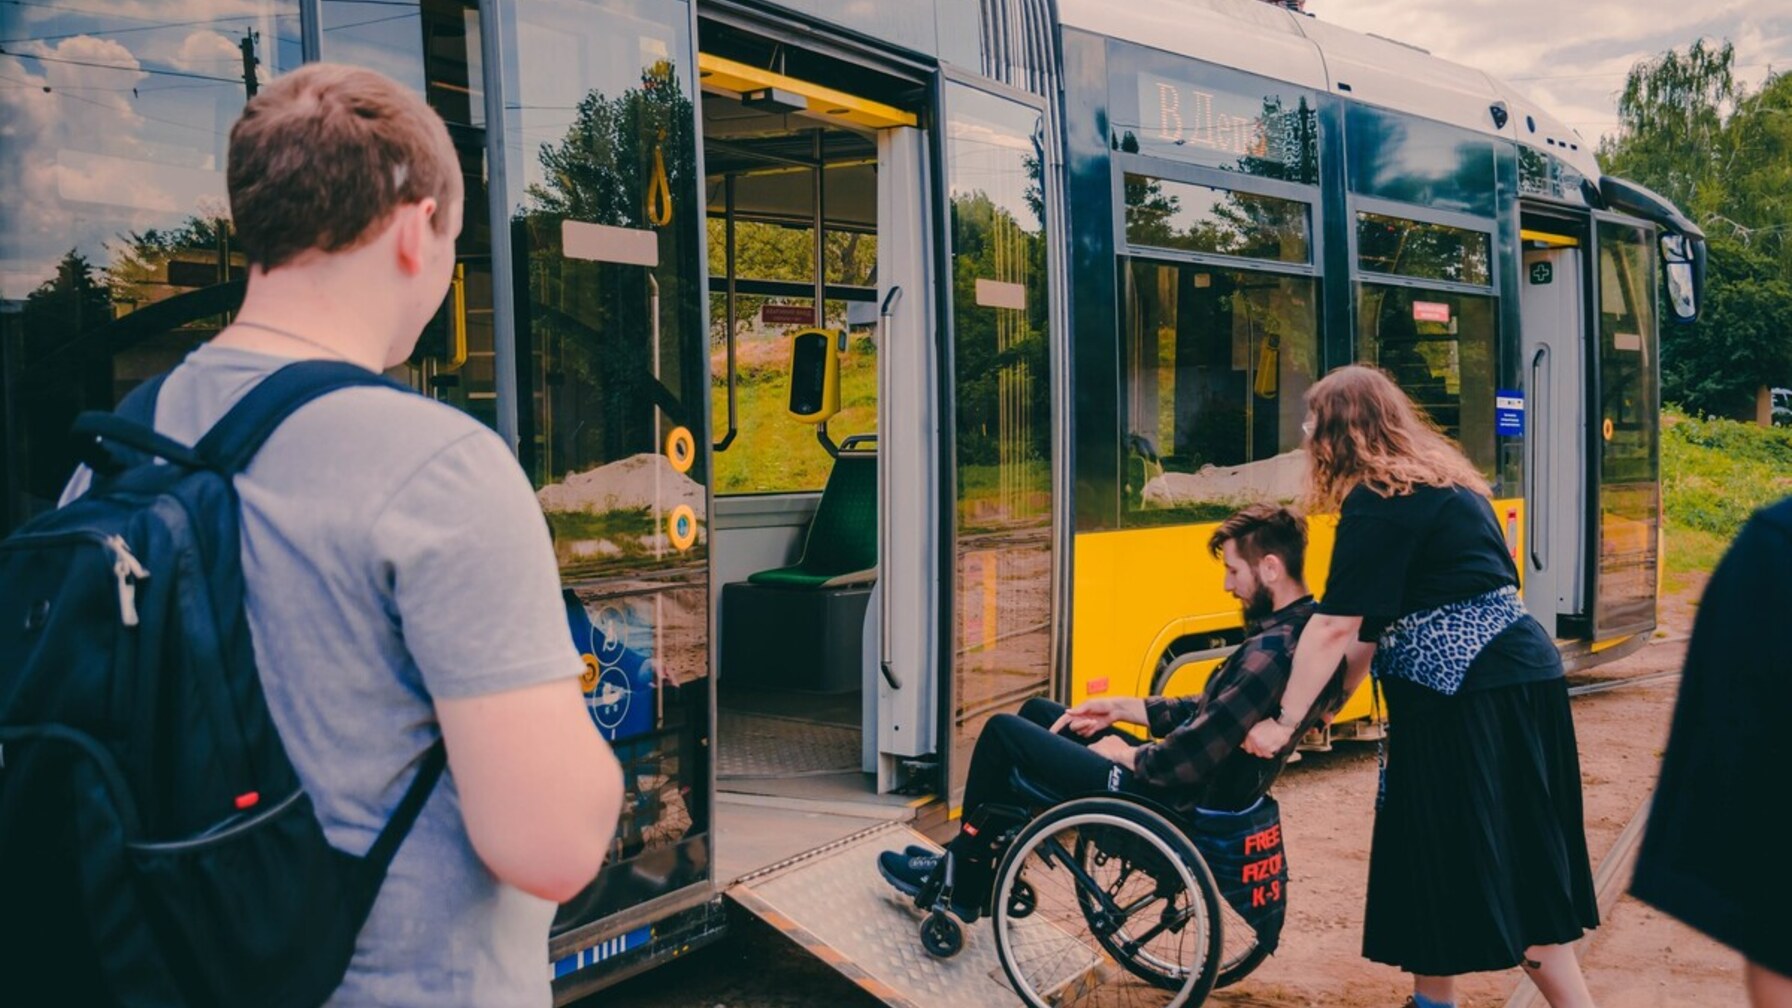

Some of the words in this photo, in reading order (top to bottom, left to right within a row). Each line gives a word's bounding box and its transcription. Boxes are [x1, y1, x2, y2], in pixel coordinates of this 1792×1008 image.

[1155, 83, 1183, 140] В
[1244, 824, 1281, 855] FREE
[1243, 852, 1283, 884] AZO
